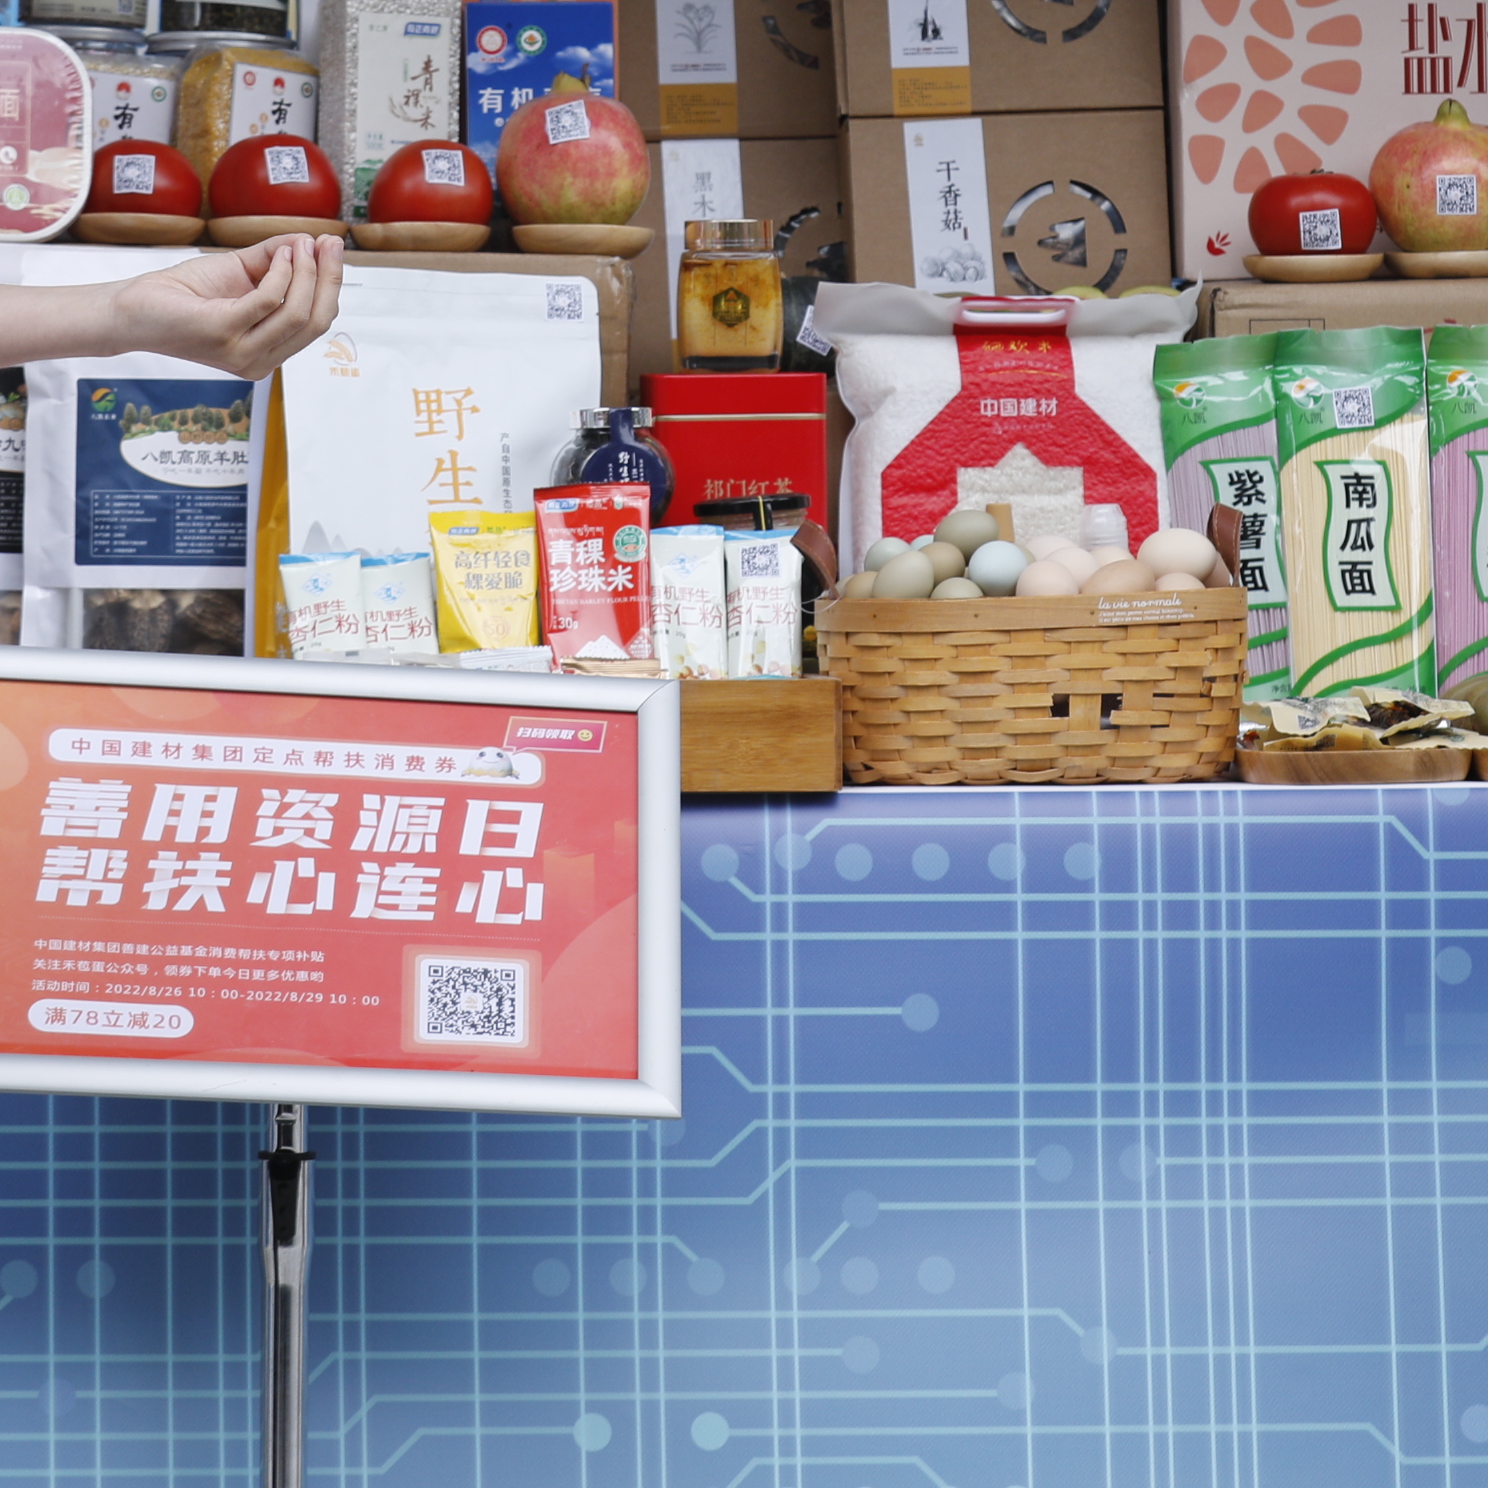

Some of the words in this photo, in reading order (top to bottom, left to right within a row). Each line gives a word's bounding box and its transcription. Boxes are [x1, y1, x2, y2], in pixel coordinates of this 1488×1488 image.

[936, 160, 963, 232] 干香菇
[980, 397, 1058, 417] 中国建材
[412, 386, 483, 505] 野生
[1338, 472, 1378, 595] 南瓜面
[454, 550, 531, 568] 高纤轻食
[548, 538, 605, 565] 青稞
[549, 564, 634, 593] 珍珠米
[1098, 597, 1112, 610] la
[1112, 597, 1130, 609] vie
[1132, 592, 1182, 608] normale
[365, 606, 419, 624] 机野生
[558, 616, 579, 630] 30g
[651, 601, 723, 629] 杏仁粉
[289, 613, 360, 646] 杏仁粉
[516, 725, 575, 743] 扫码领取
[71, 737, 457, 775] 中国建材集团定点帮扶消费券
[40, 777, 544, 858] 善用资源日
[36, 845, 544, 925] 帮扶心连心
[34, 938, 325, 963] 中国建材集团善建公益基金消费帮扶专项补贴
[45, 1005, 182, 1031] 满78立减20
